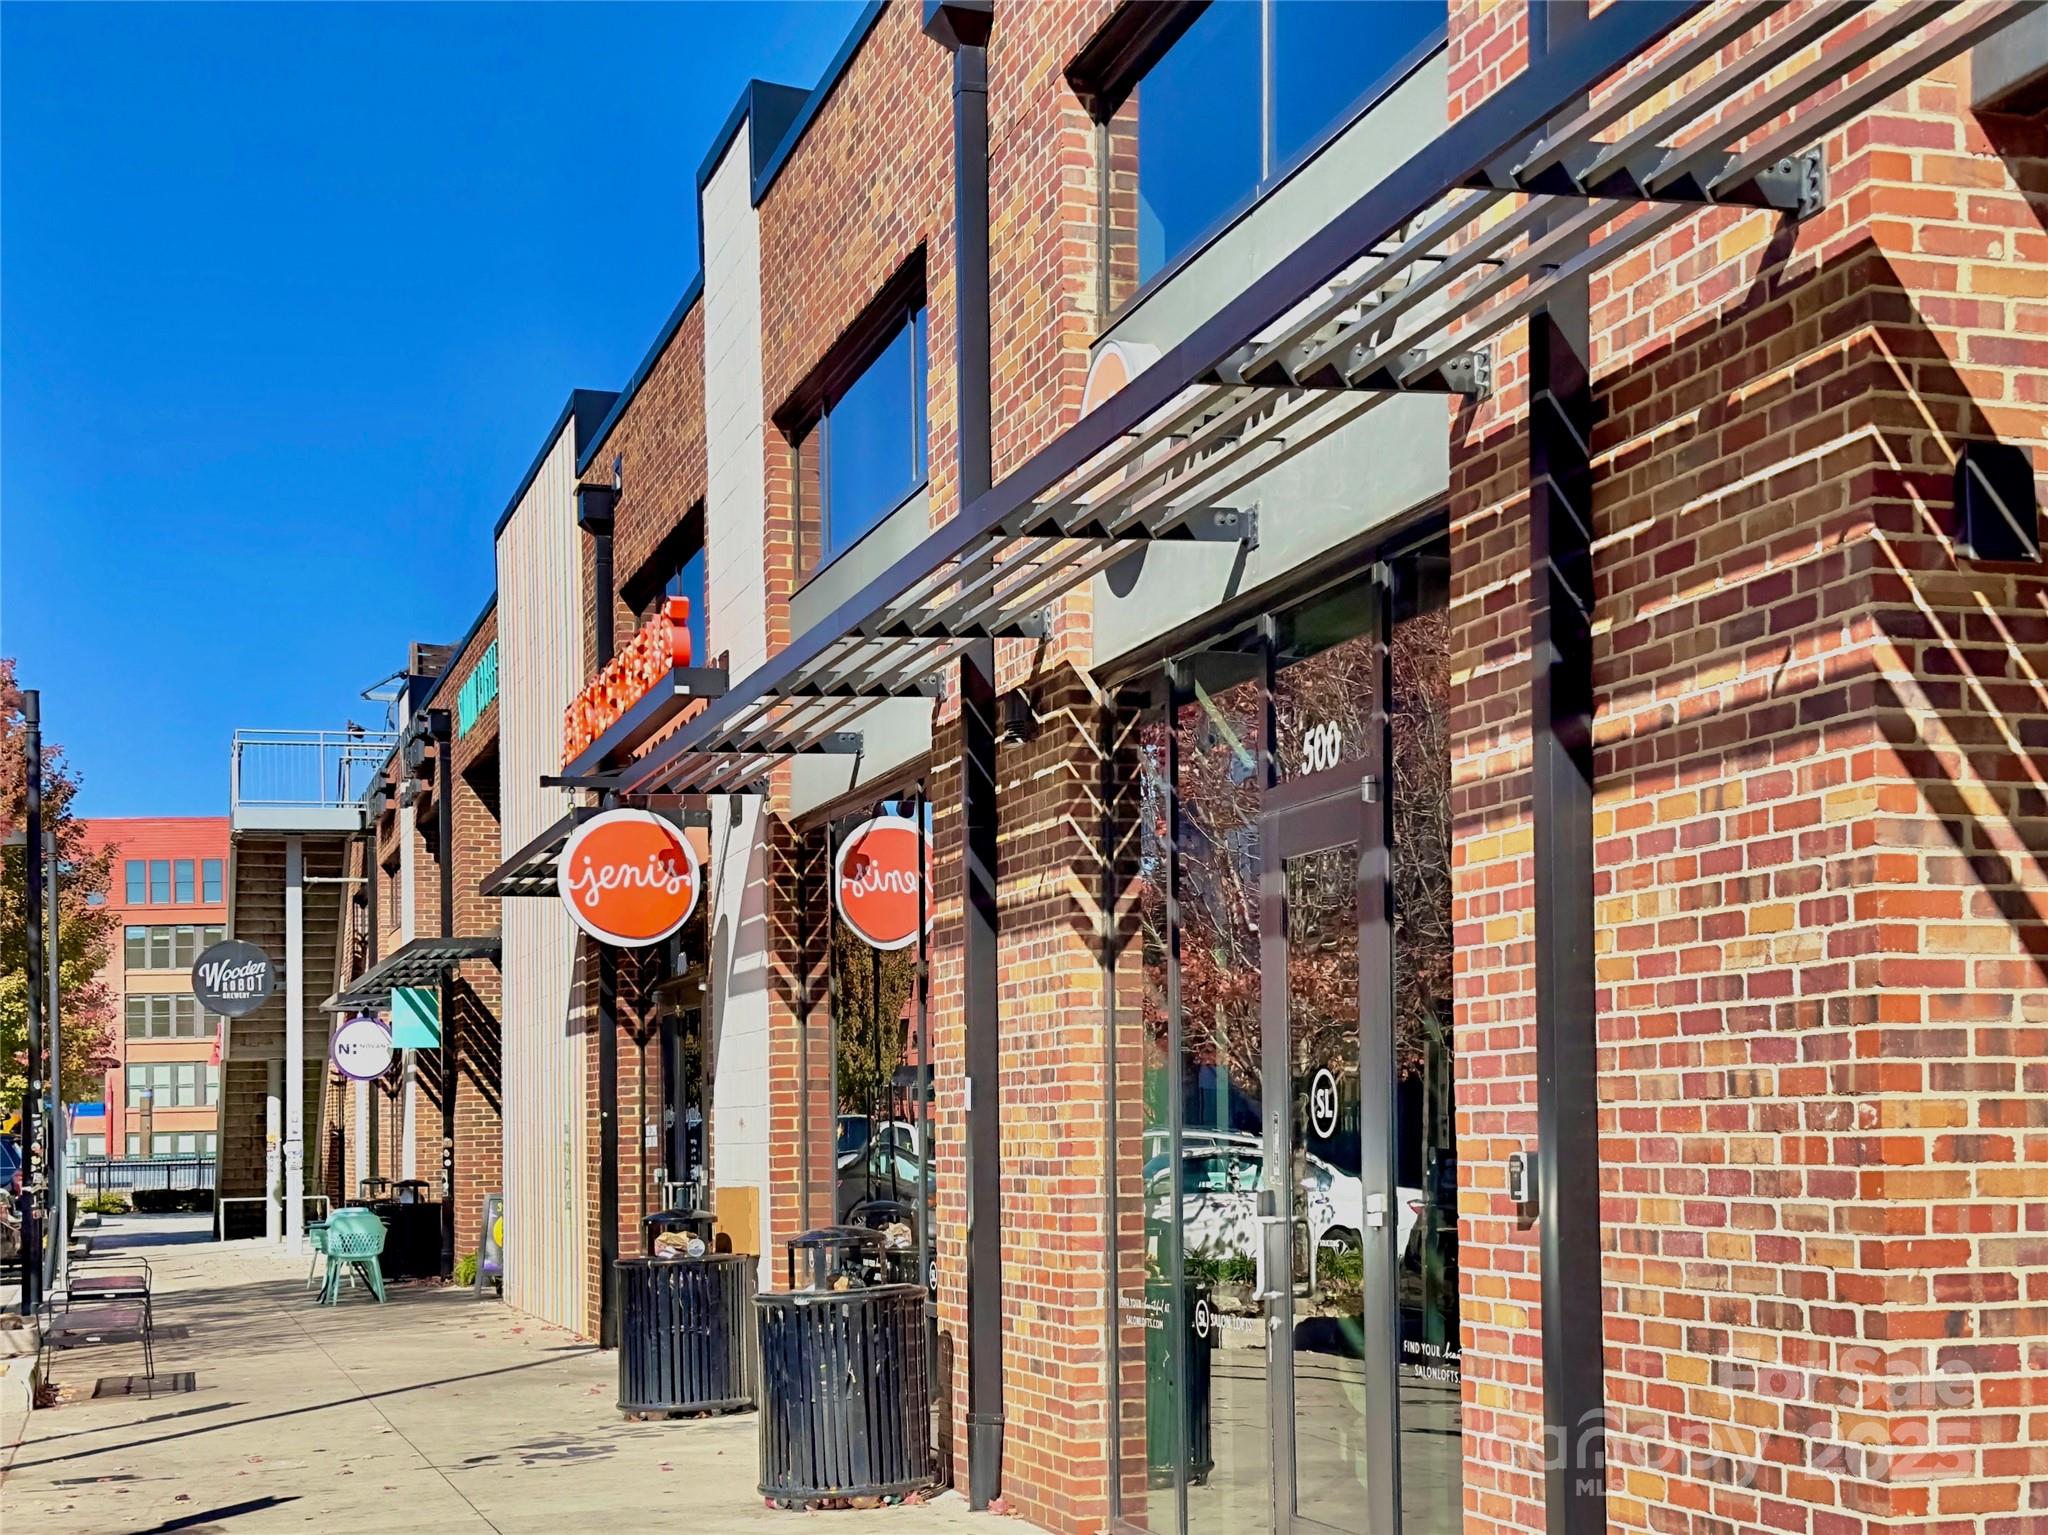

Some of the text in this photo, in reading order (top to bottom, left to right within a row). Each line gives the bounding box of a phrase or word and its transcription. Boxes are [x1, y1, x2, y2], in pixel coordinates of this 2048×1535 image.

[1301, 720, 1341, 776] 500
[568, 854, 692, 907] jeni's
[198, 958, 267, 993] Wooden
[222, 974, 265, 992] ROBOT
[1316, 1088, 1333, 1119] SL
[1210, 1313, 1231, 1329] SALON
[1403, 1340, 1420, 1354] FIND
[1420, 1343, 1441, 1358] YOUR
